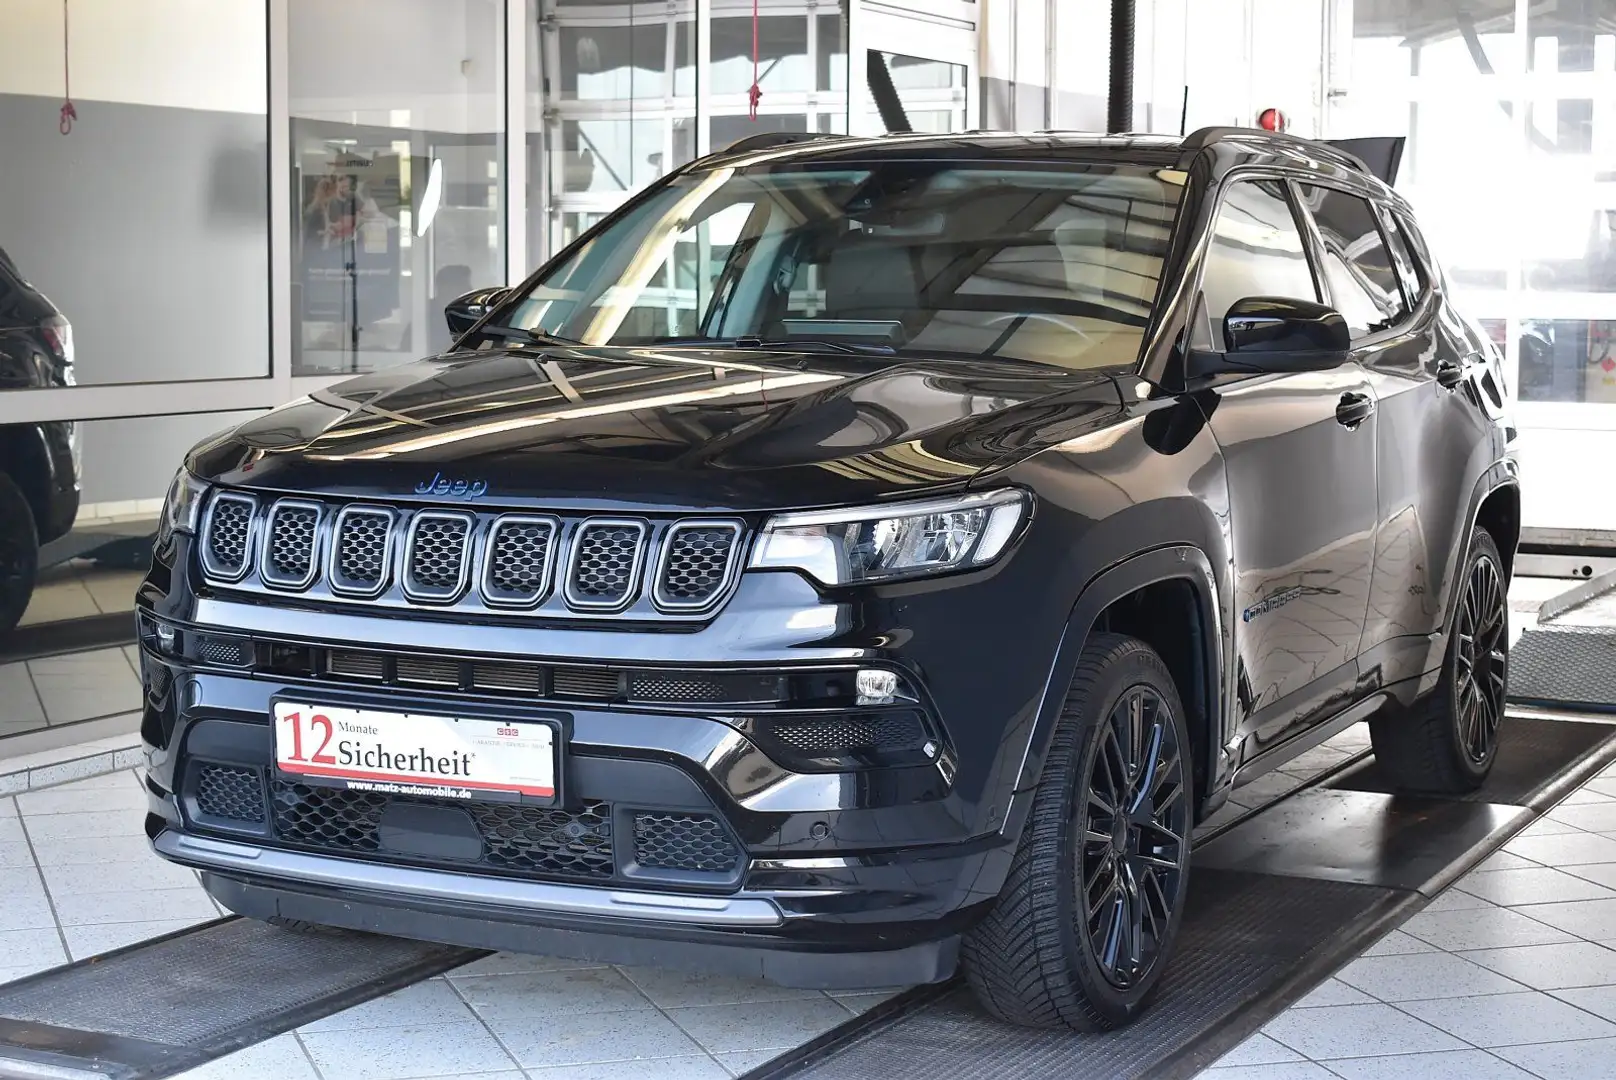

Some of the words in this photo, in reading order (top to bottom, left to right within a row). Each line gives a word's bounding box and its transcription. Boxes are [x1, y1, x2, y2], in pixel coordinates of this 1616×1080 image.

[414, 472, 487, 501] Jeep
[283, 711, 336, 766] 12
[339, 721, 378, 736] Monate
[347, 780, 472, 799] www.matz-automobile.de
